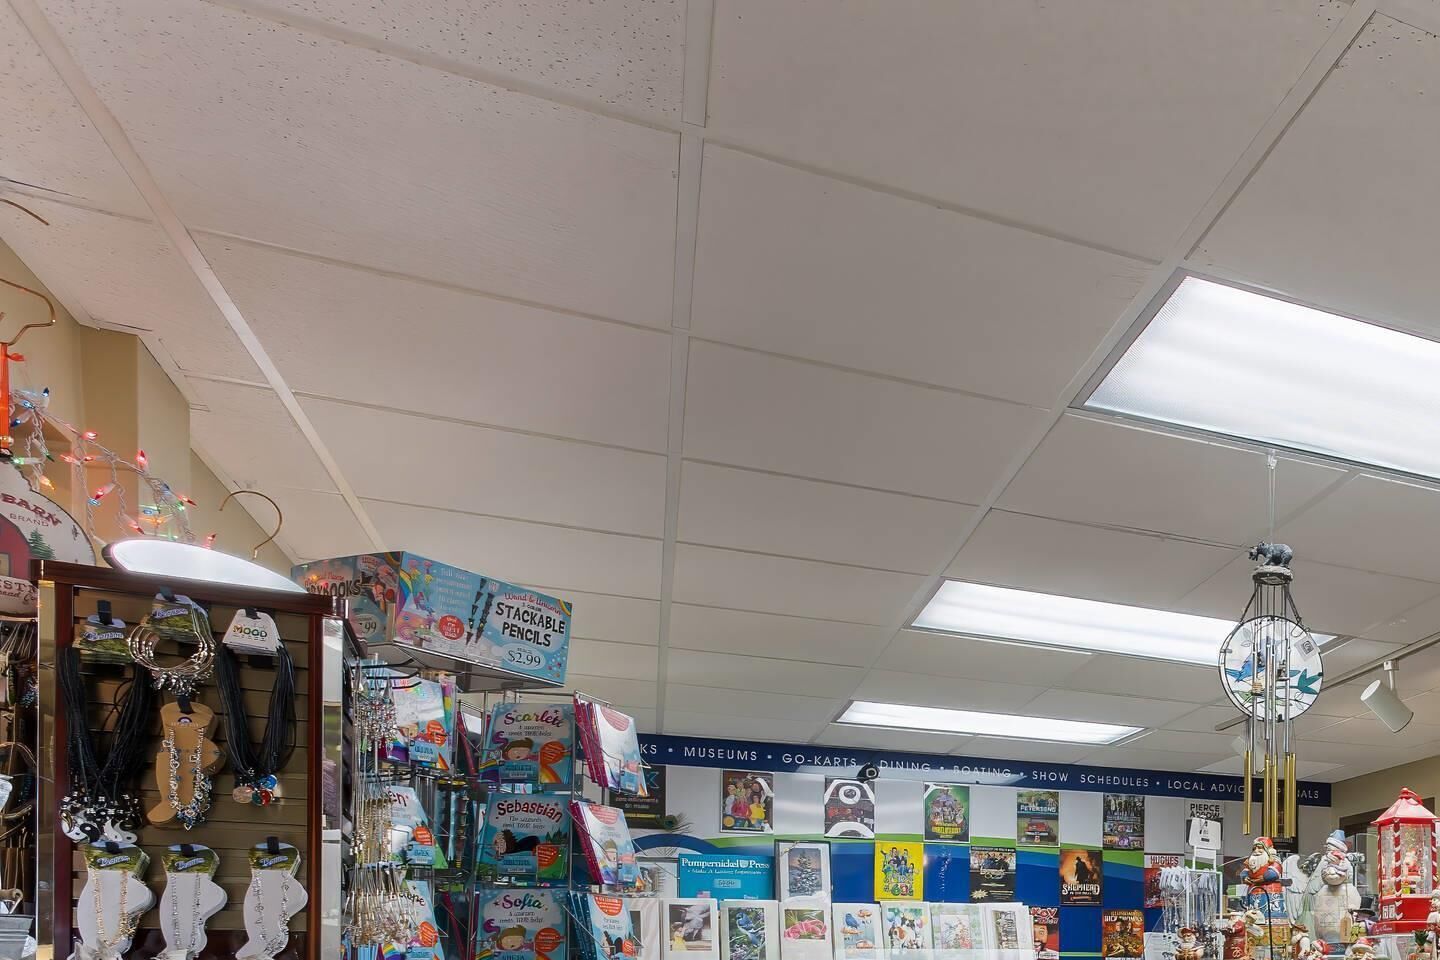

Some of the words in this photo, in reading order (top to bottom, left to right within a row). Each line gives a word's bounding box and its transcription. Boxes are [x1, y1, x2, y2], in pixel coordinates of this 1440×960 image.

[10, 513, 49, 527] BRAND
[496, 602, 566, 635] STACKABLE
[233, 625, 267, 637] MOOD
[502, 624, 551, 647] PENCILS
[508, 649, 541, 667] $2.99
[504, 709, 565, 729] Scarlett
[684, 747, 758, 761] MUSEUMS
[782, 753, 857, 768] GO-KARTS
[880, 760, 930, 772] DINING
[953, 766, 1011, 777] BOATING
[1032, 771, 1069, 782] SHOW
[1080, 774, 1149, 788] SCHEDULES
[1168, 780, 1206, 792] LOCAL
[1211, 784, 1246, 794] ADVIC
[497, 801, 563, 823] Sebastian
[1190, 804, 1220, 812] PIERCE
[682, 857, 739, 868] Pumpernickel
[749, 860, 770, 869] Press
[1151, 856, 1179, 866] HUGHES
[1062, 884, 1100, 895] SHEPHERD
[501, 894, 545, 912] Sofia
